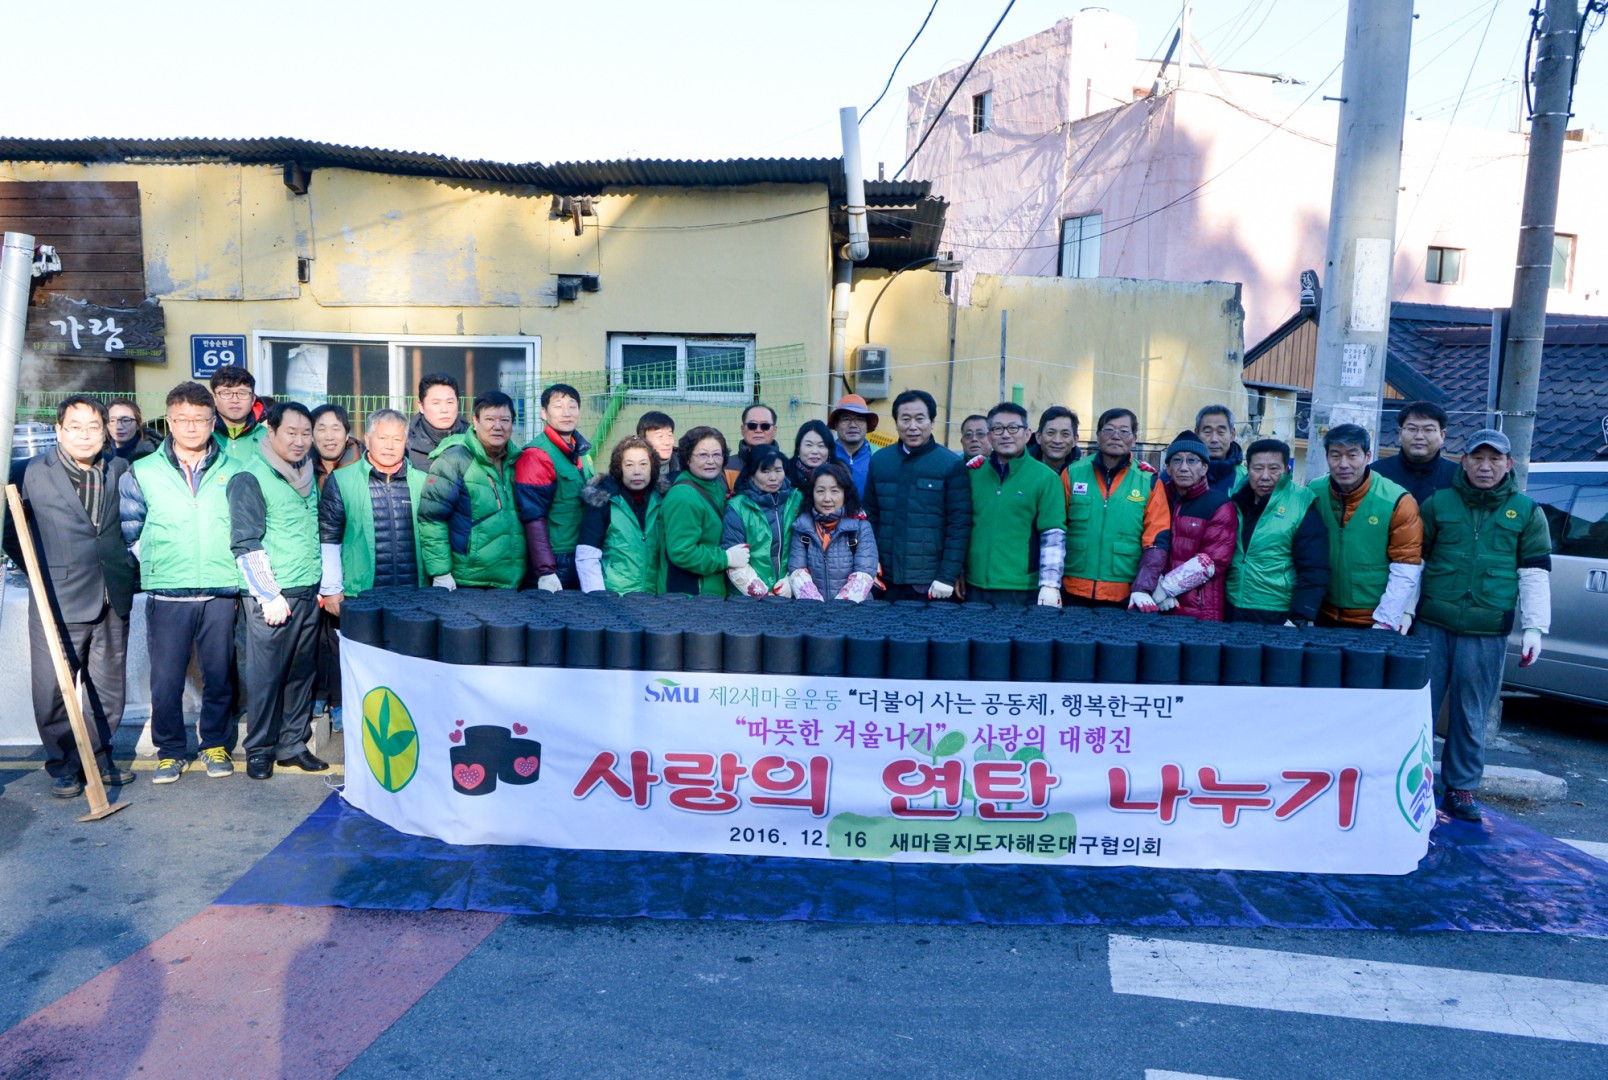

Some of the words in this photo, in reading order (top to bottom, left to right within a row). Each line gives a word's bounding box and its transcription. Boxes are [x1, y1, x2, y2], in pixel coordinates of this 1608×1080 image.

[49, 316, 125, 352] 가람
[202, 340, 235, 348] 반송순환로
[203, 350, 235, 367] 69
[644, 683, 699, 703] SMU
[708, 686, 841, 711] 제2새마을운동
[930, 691, 976, 714] 사는
[981, 693, 1055, 717] 공동체,
[972, 724, 1046, 753] 사랑의
[1059, 726, 1131, 754] 대행진
[572, 748, 831, 818] 사랑의
[881, 758, 1060, 820] 연탄
[1107, 763, 1360, 830] 나누기
[729, 827, 788, 846] 2016.
[801, 829, 831, 848] 12.
[844, 831, 867, 848] 16
[890, 832, 1163, 857] 새마을지도자해운대구협의회
